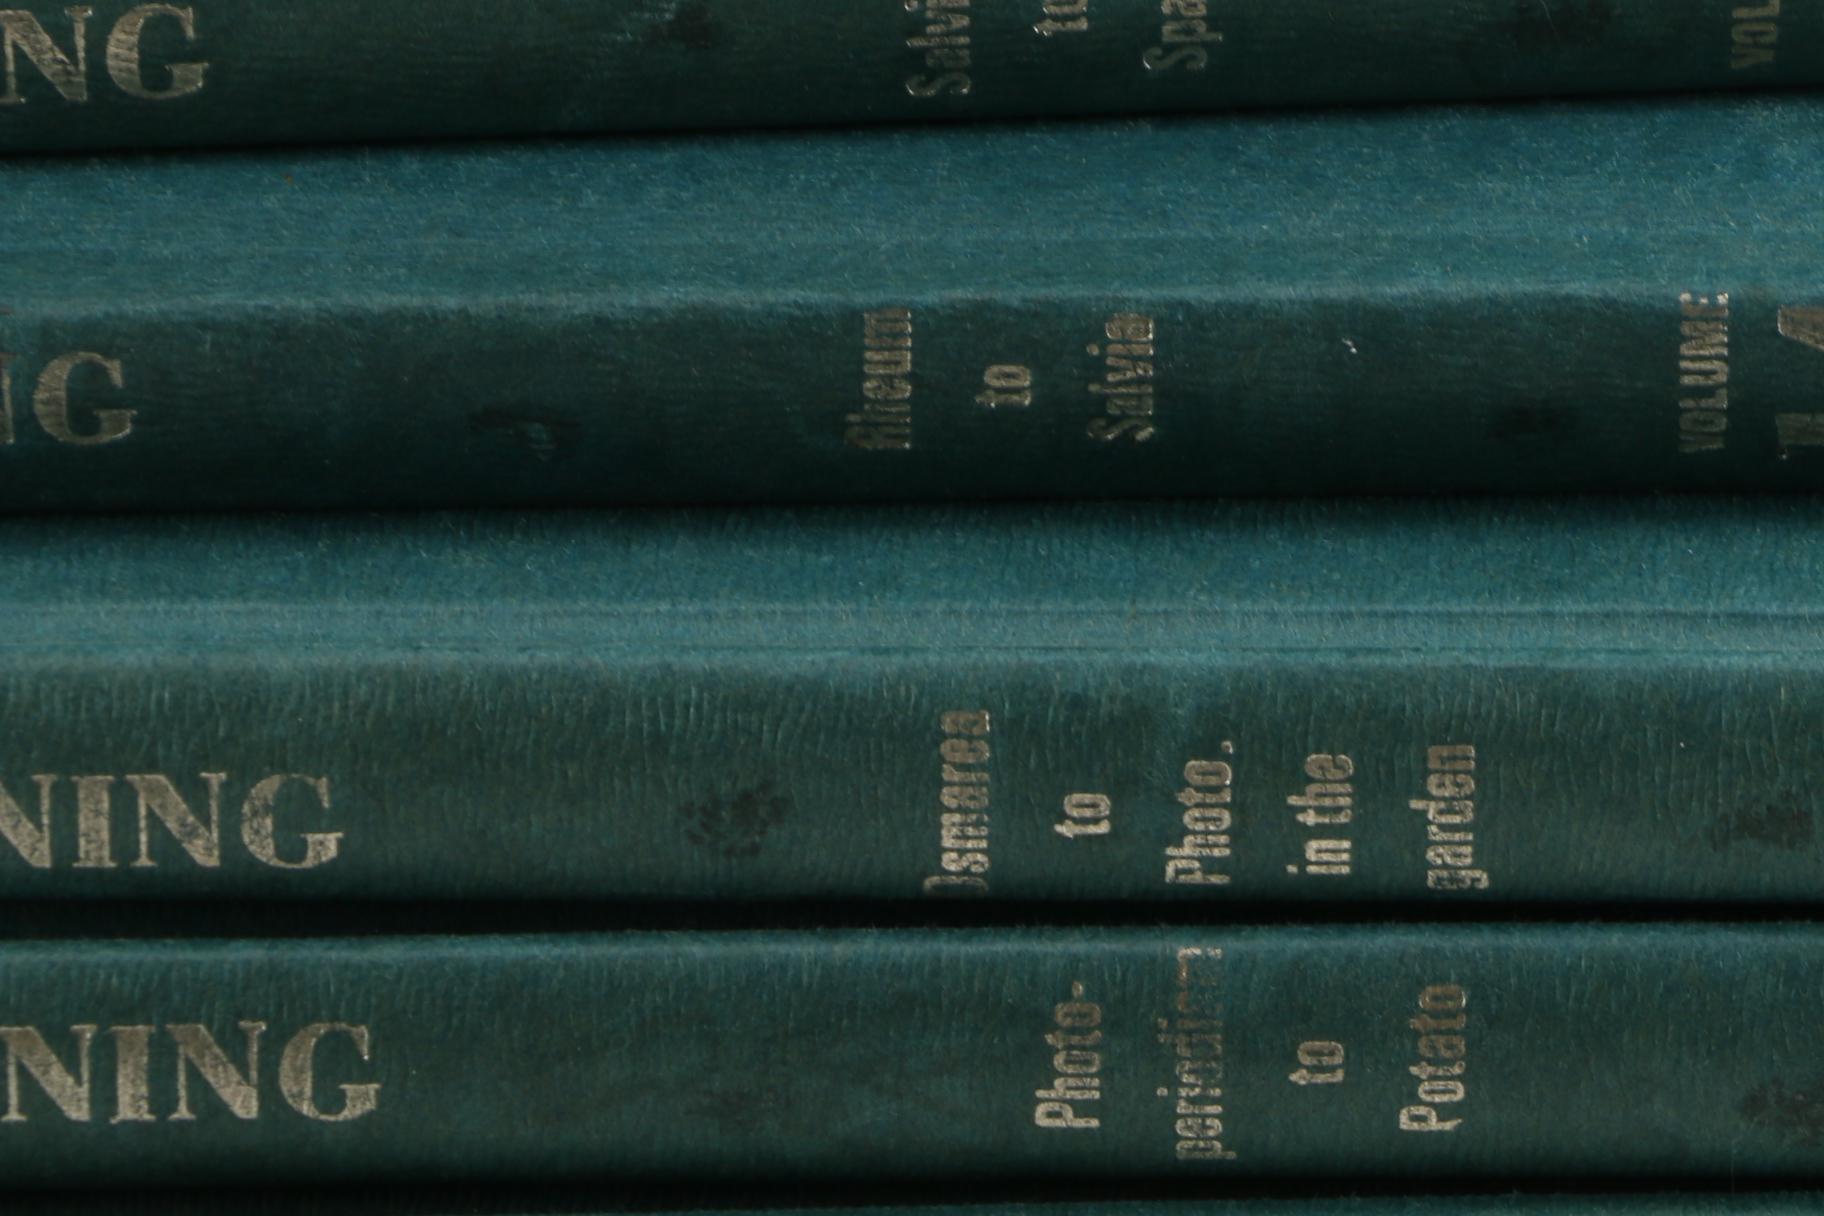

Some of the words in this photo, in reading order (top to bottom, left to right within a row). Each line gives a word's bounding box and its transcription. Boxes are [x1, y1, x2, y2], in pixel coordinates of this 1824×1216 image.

[0, 350, 137, 447] G
[843, 309, 915, 449] Rheum
[977, 363, 1032, 405] to
[1088, 314, 1155, 443] Salvia
[1677, 293, 1729, 449] VOLUME
[1055, 792, 1112, 837] to
[1287, 752, 1355, 824] the
[1410, 743, 1491, 889] garden
[1288, 838, 1352, 874] in
[1032, 981, 1103, 1128] Photo-
[1289, 1039, 1345, 1085] to
[1398, 984, 1468, 1131] Potato
